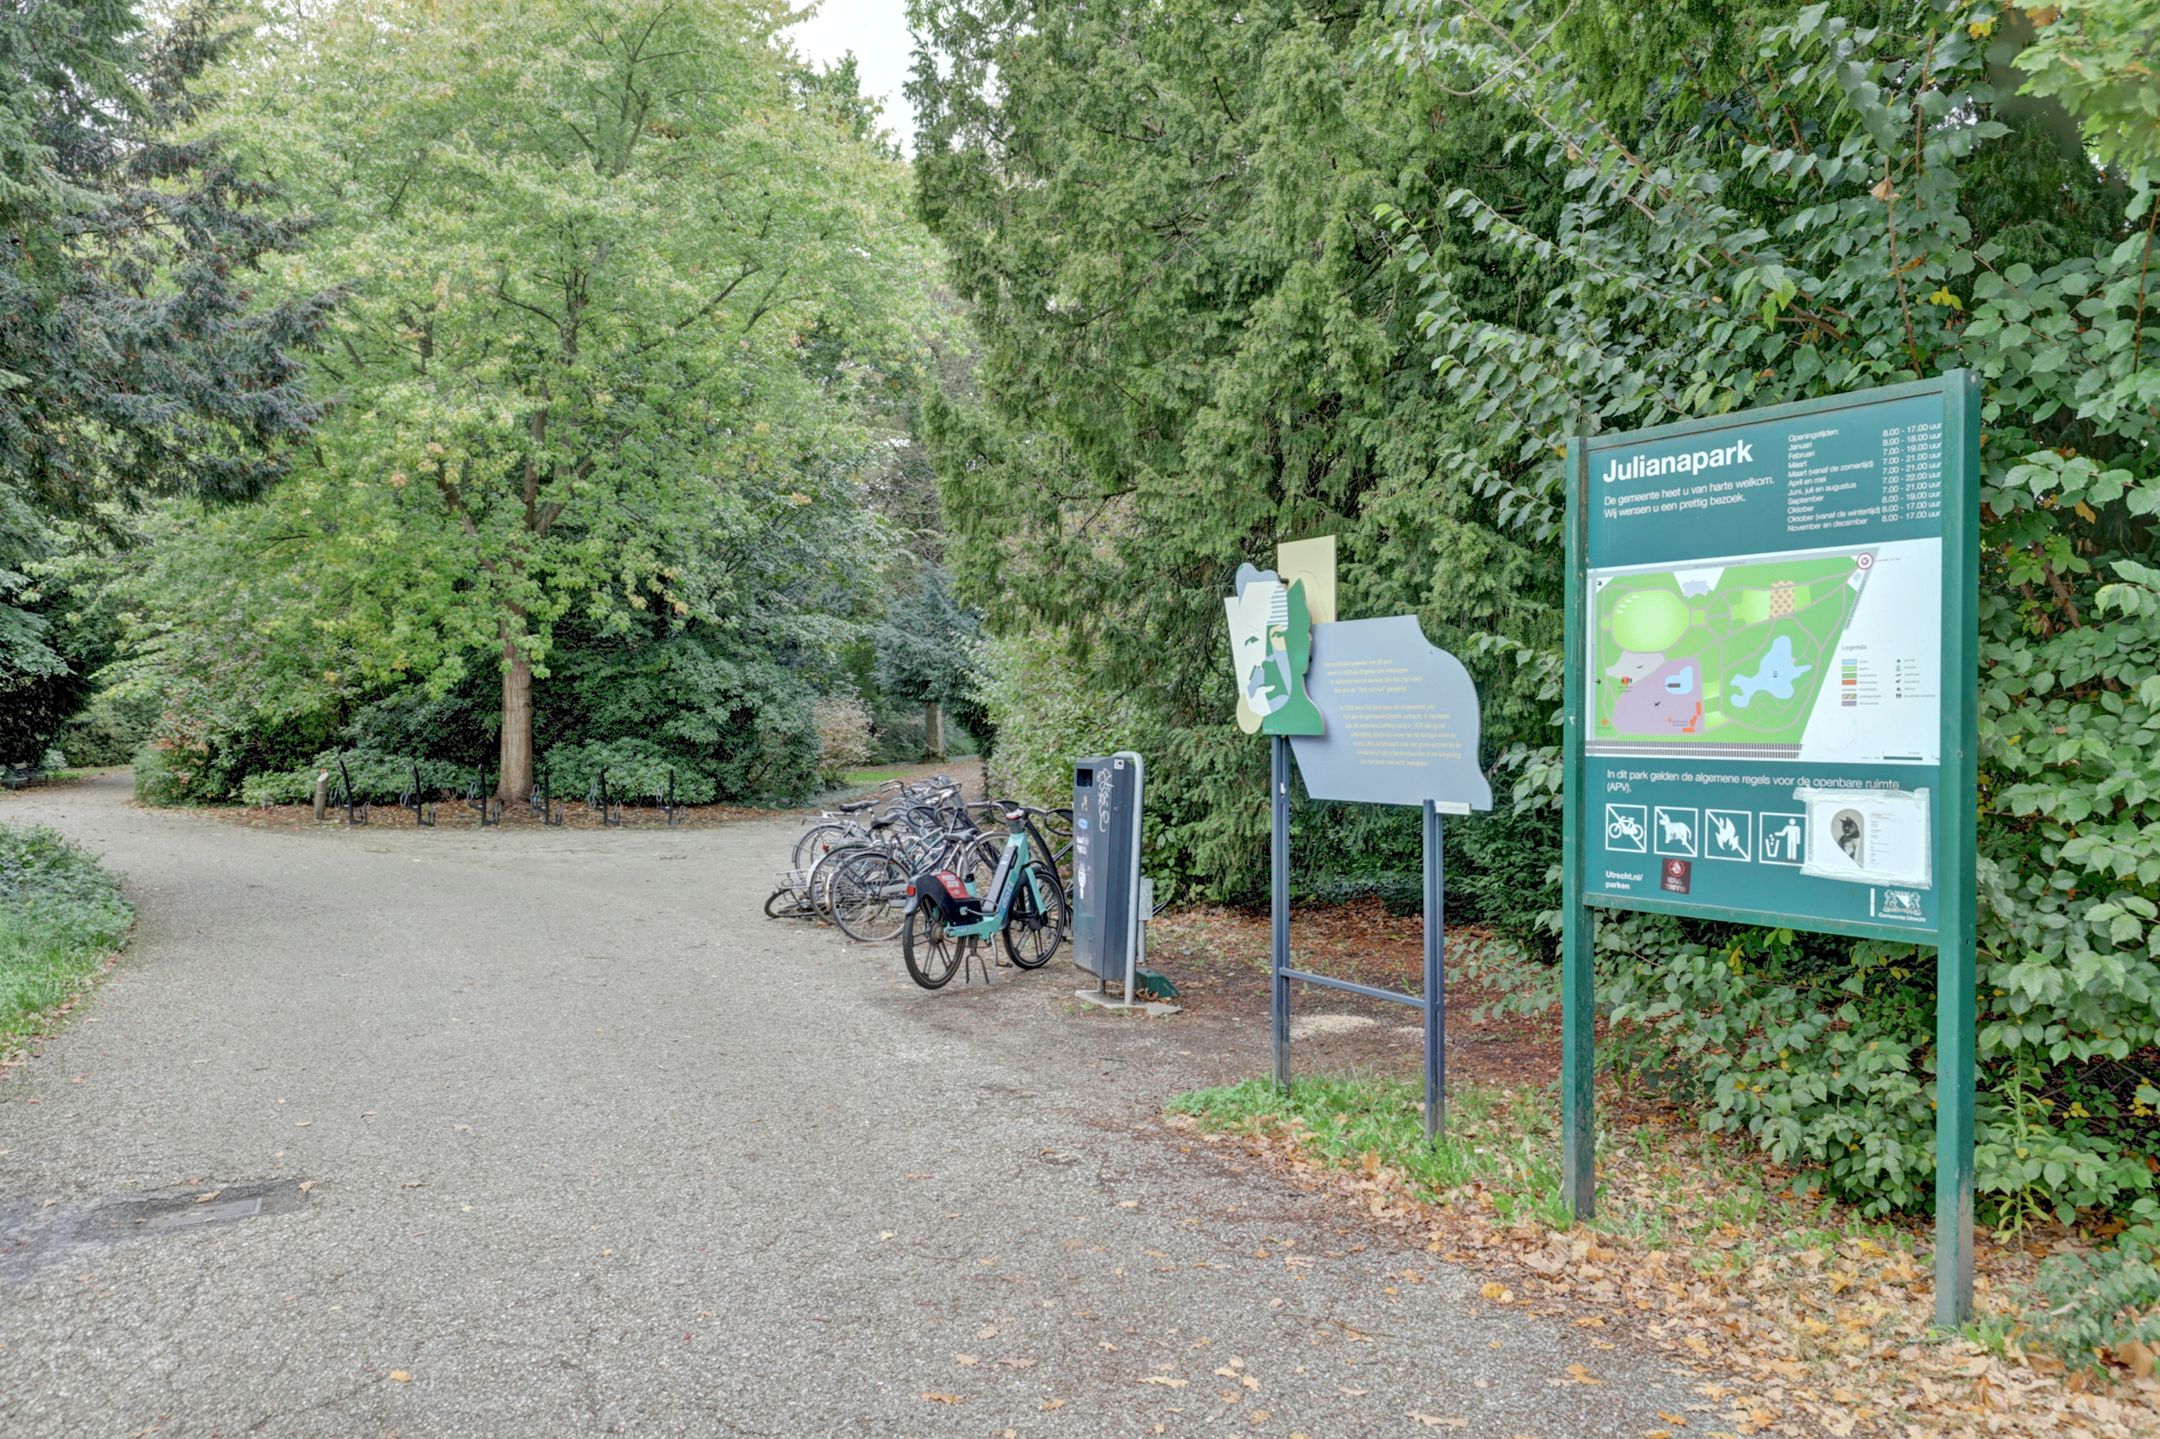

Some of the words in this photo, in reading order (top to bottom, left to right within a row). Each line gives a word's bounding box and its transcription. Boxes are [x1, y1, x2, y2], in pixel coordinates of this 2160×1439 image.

[1788, 429, 1840, 442] Openingstijden:
[1882, 428, 1900, 437] 8.00
[1907, 424, 1929, 433] 17.00
[1882, 437, 1900, 447] 8.00
[1907, 433, 1929, 442] 18.00
[1929, 432, 1942, 440] uur
[1788, 442, 1813, 451] Januari
[1882, 447, 1900, 456] 7.00
[1907, 443, 1928, 452] 19.00
[1929, 442, 1942, 450] uur
[1603, 440, 1753, 482] Julianapark
[1788, 450, 1815, 460] Februari
[1882, 456, 1900, 465] 7.00
[1906, 452, 1928, 462] 21.00
[1788, 461, 1808, 469] Maart
[1788, 470, 1808, 478] Maart
[1808, 466, 1829, 476] (vanaf
[1829, 465, 1839, 473] de
[1840, 460, 1874, 471] zomertijd)
[1882, 466, 1900, 474] 7.00
[1906, 462, 1928, 472] 21.00
[1788, 479, 1803, 487] April
[1882, 475, 1900, 485] 7.00
[1905, 472, 1928, 482] 22.00
[1929, 471, 1942, 479] uur
[1604, 496, 1616, 505] De
[1618, 490, 1660, 505] gemeente
[1661, 488, 1681, 498] heet
[1683, 488, 1689, 496] u
[1691, 485, 1707, 495] van
[1709, 482, 1733, 492] harte
[1735, 475, 1775, 488] welkom.
[1804, 486, 1814, 496] juli
[1825, 482, 1857, 492] augustus
[1882, 485, 1899, 494] 7.00
[1905, 482, 1928, 491] 21.00
[1928, 481, 1942, 489] uur
[1788, 496, 1824, 505] September
[1882, 494, 1899, 504] 8.00
[1906, 491, 1928, 501] 19.00
[1604, 508, 1617, 519] Wij
[1619, 505, 1651, 517] wensen
[1652, 504, 1659, 513] u
[1661, 502, 1677, 512] een
[1679, 498, 1708, 512] prettig
[1710, 492, 1746, 506] bezoek.
[1787, 506, 1815, 514] Oktober
[1881, 504, 1899, 513] 8.00
[1906, 501, 1927, 510] 17.00
[1787, 514, 1814, 523] Oktober
[1815, 511, 1836, 520] (vanaf
[1847, 506, 1880, 516] wintertijd)
[1881, 513, 1899, 523] 8.00
[1906, 510, 1927, 520] 17.00
[1928, 510, 1942, 518] uur
[1787, 523, 1821, 532] November
[1833, 518, 1868, 528] december
[1841, 644, 1868, 652] Legenda
[1607, 769, 1615, 779] In
[1616, 769, 1628, 780] dit
[1629, 770, 1648, 782] park
[1650, 771, 1679, 783] gelden
[1681, 771, 1694, 782] de
[1695, 772, 1740, 785] algemene
[1742, 773, 1771, 786] regels
[1773, 777, 1794, 786] voor
[1797, 776, 1809, 787] de
[1813, 777, 1863, 789] openbare
[1865, 778, 1901, 790] ruimte
[1607, 782, 1632, 793] (APV).
[1605, 870, 1643, 881] Utrecht.nl/
[1605, 881, 1631, 890] parken
